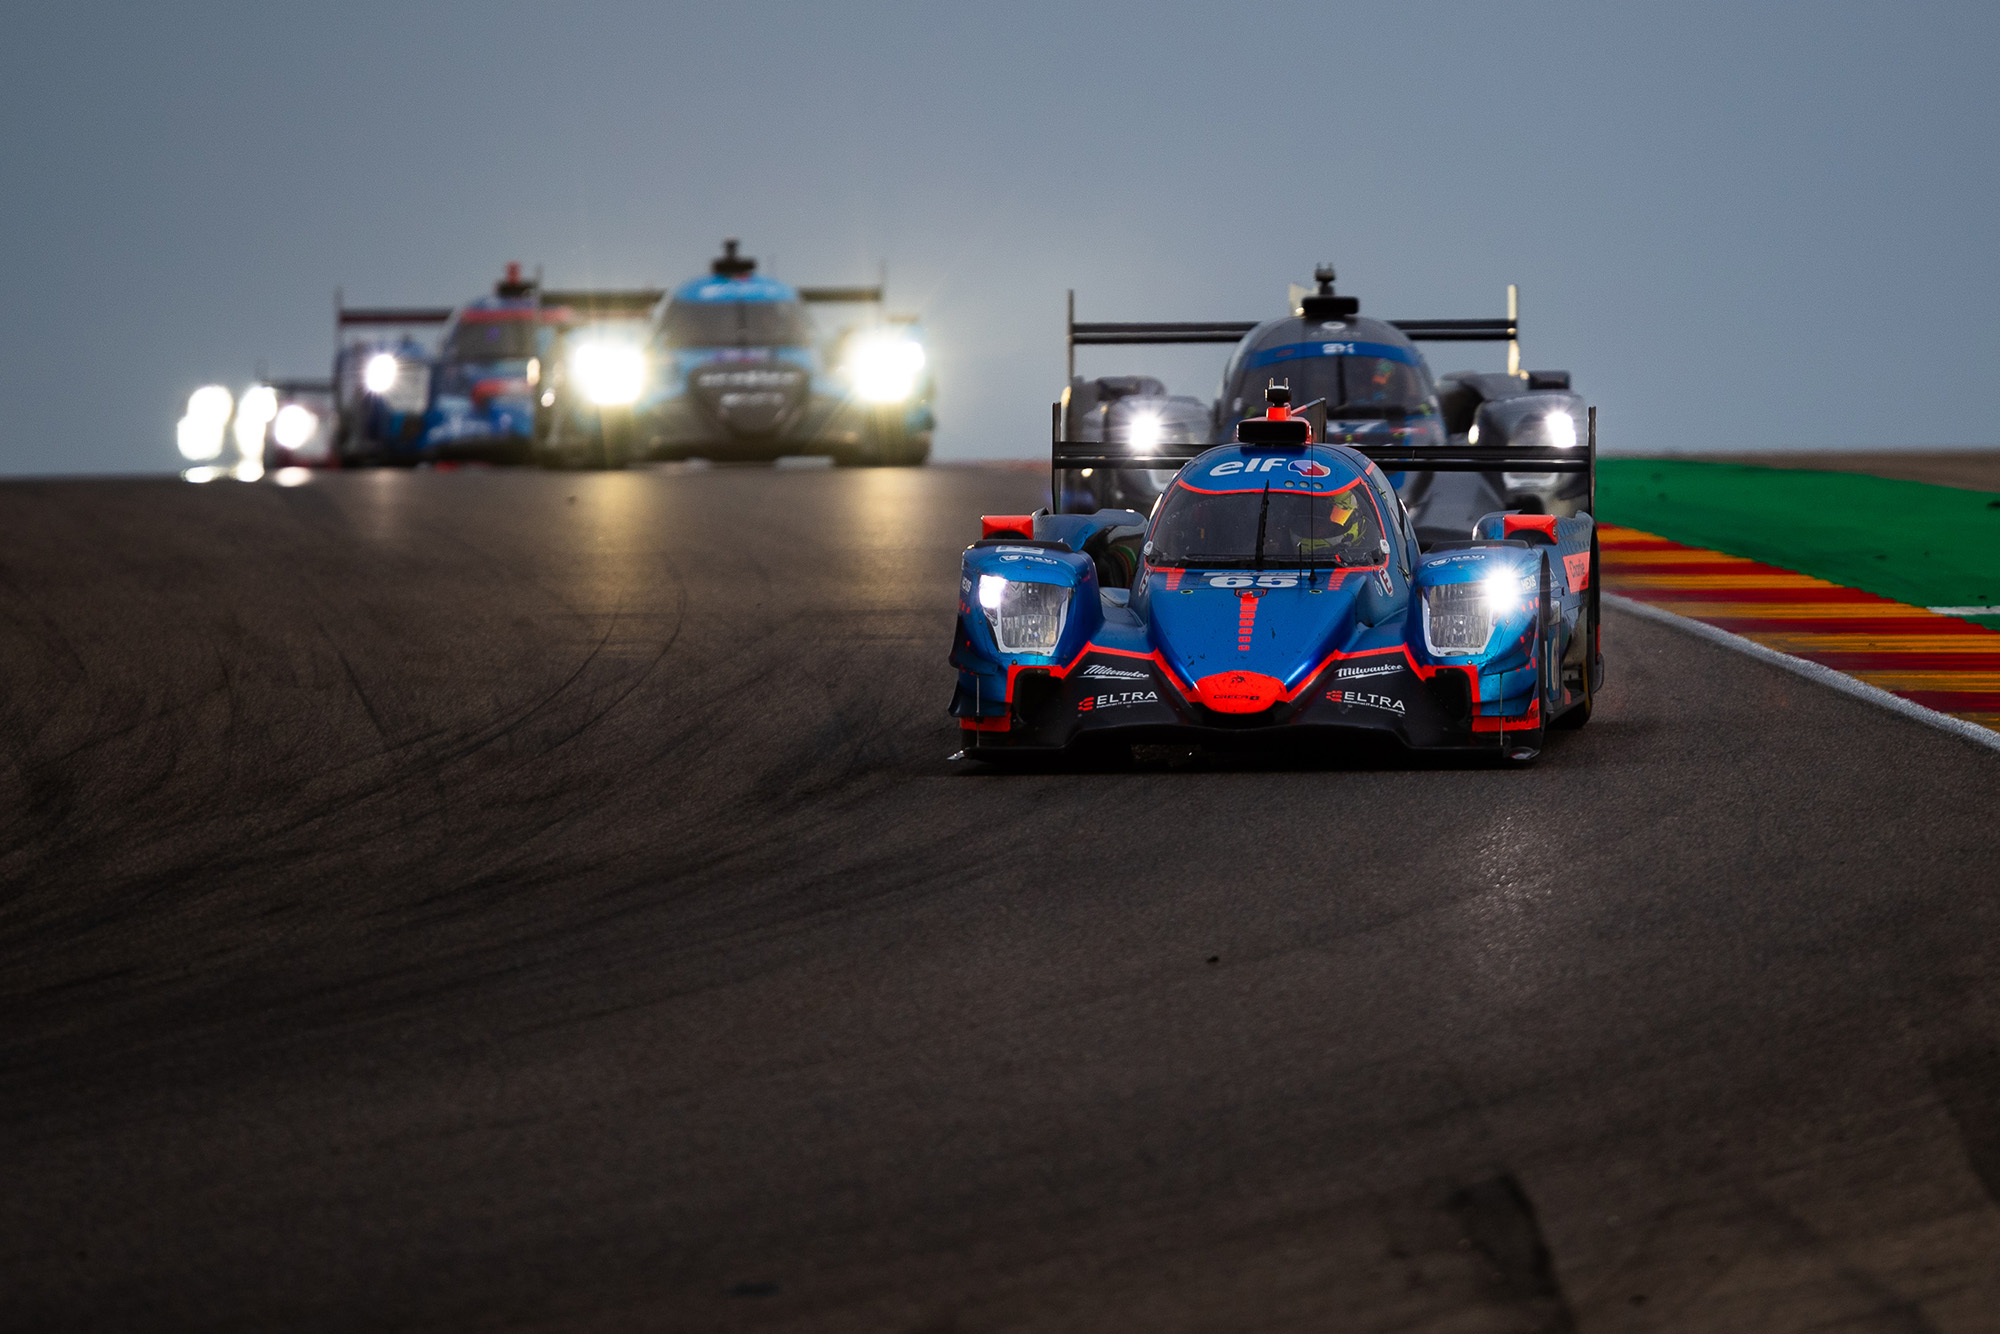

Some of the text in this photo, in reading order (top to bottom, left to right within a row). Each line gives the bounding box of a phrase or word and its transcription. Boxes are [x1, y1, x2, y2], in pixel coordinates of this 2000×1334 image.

[1209, 458, 1287, 476] elf
[1209, 576, 1298, 588] 65
[1083, 664, 1150, 678] Milwaukee
[1334, 663, 1404, 678] Milwaukee
[1096, 691, 1158, 705] ELTRA
[1344, 691, 1406, 711] ELTRA
